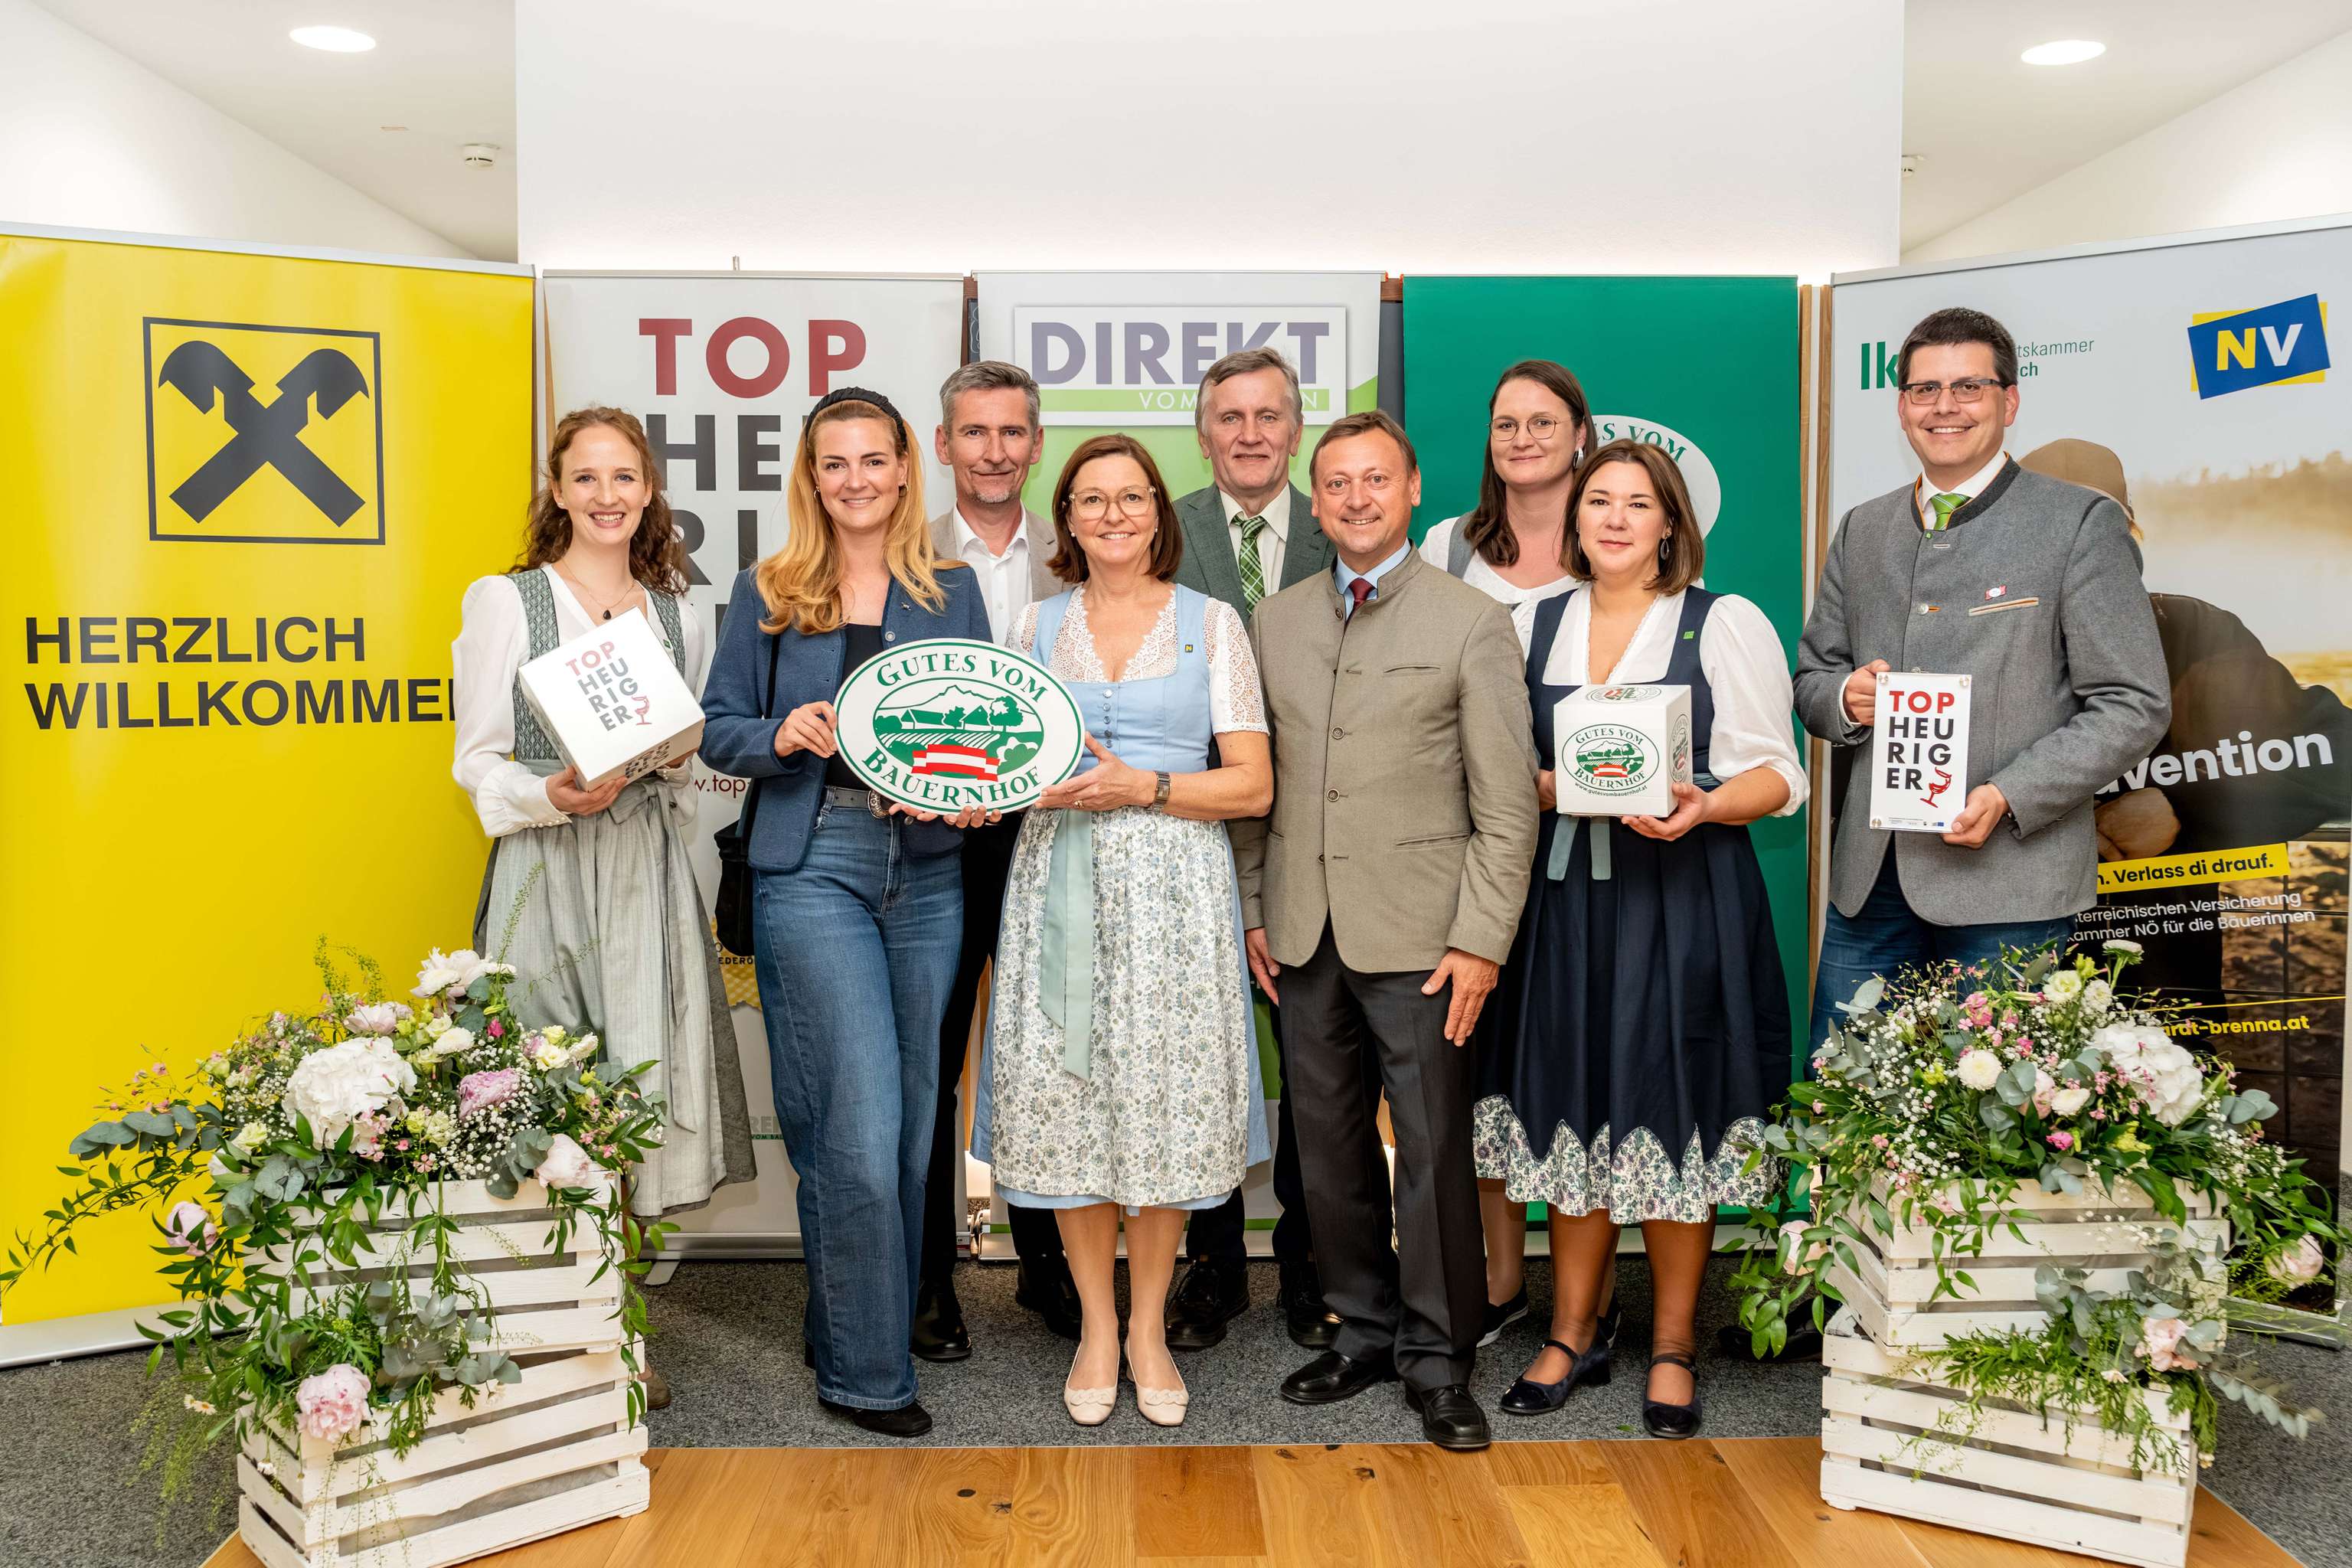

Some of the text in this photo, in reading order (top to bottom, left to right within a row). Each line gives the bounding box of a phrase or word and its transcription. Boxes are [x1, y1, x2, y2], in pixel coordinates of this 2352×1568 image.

[639, 316, 867, 399] TOP
[2216, 323, 2304, 371] NV
[646, 414, 810, 492] HE
[26, 616, 365, 664] HERZLICH
[565, 641, 615, 677] TOP
[577, 657, 629, 696] HEU
[877, 653, 1048, 703] GUTES VOM
[24, 678, 455, 730] WILLKOMME
[588, 678, 639, 714] RIG
[1889, 691, 1955, 714] TOP
[599, 705, 633, 731] ER
[1889, 717, 1954, 740] HEU
[1575, 727, 1645, 746] GUTES VOM
[1887, 742, 1952, 766] RIG
[2095, 730, 2334, 795] vention
[861, 746, 1042, 807] BAUERNHOF
[1573, 767, 1646, 789] BAUERNHOF
[1574, 782, 1648, 797] www.gutesvombauernhof.at
[1886, 767, 1923, 790] ER
[2113, 865, 2184, 884] Verlass
[2190, 859, 2208, 876] di
[2212, 852, 2274, 874] drauf.
[2190, 893, 2301, 913] Versicherung
[2134, 920, 2159, 936] NÖ
[2163, 919, 2184, 934] für
[2188, 917, 2214, 932] die
[2218, 910, 2316, 929] Bäuerinnen
